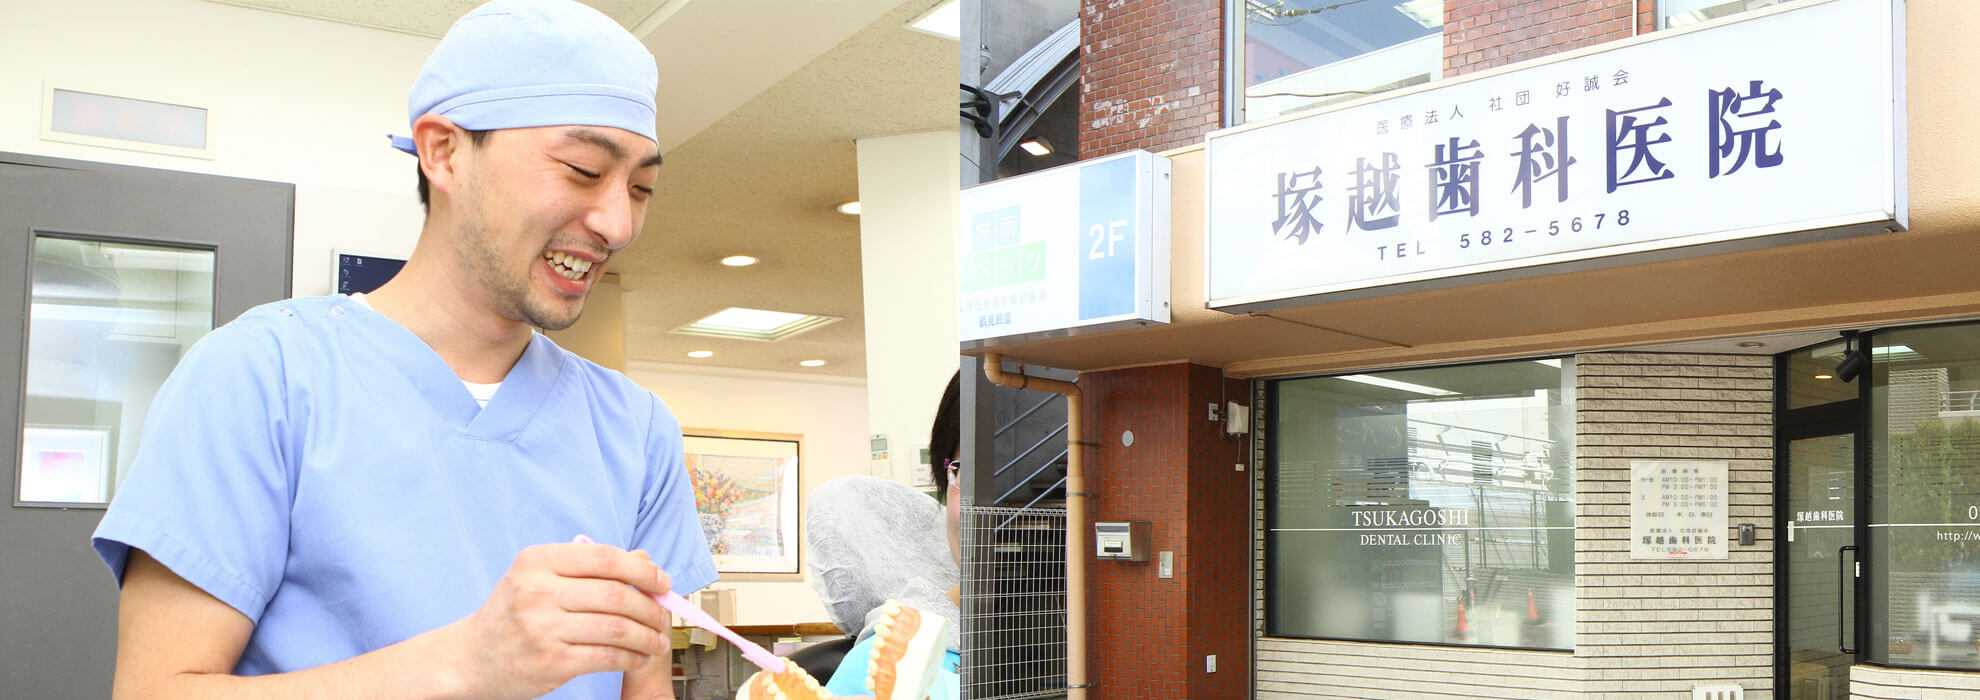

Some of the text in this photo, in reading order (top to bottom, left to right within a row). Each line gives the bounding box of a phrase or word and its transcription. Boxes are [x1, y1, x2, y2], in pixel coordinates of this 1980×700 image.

[1376, 69, 1629, 135] 医療法人 社団 好誠会
[1271, 80, 1784, 246] 塚越歯科医院
[1088, 219, 1128, 260] 2F
[1377, 209, 1630, 261] TEL 582-5678
[1352, 509, 1469, 527] TSUKAGOSHI
[1360, 534, 1462, 546] DENTAL CLINIC
[1642, 535, 1717, 545] 塚越歯科医院
